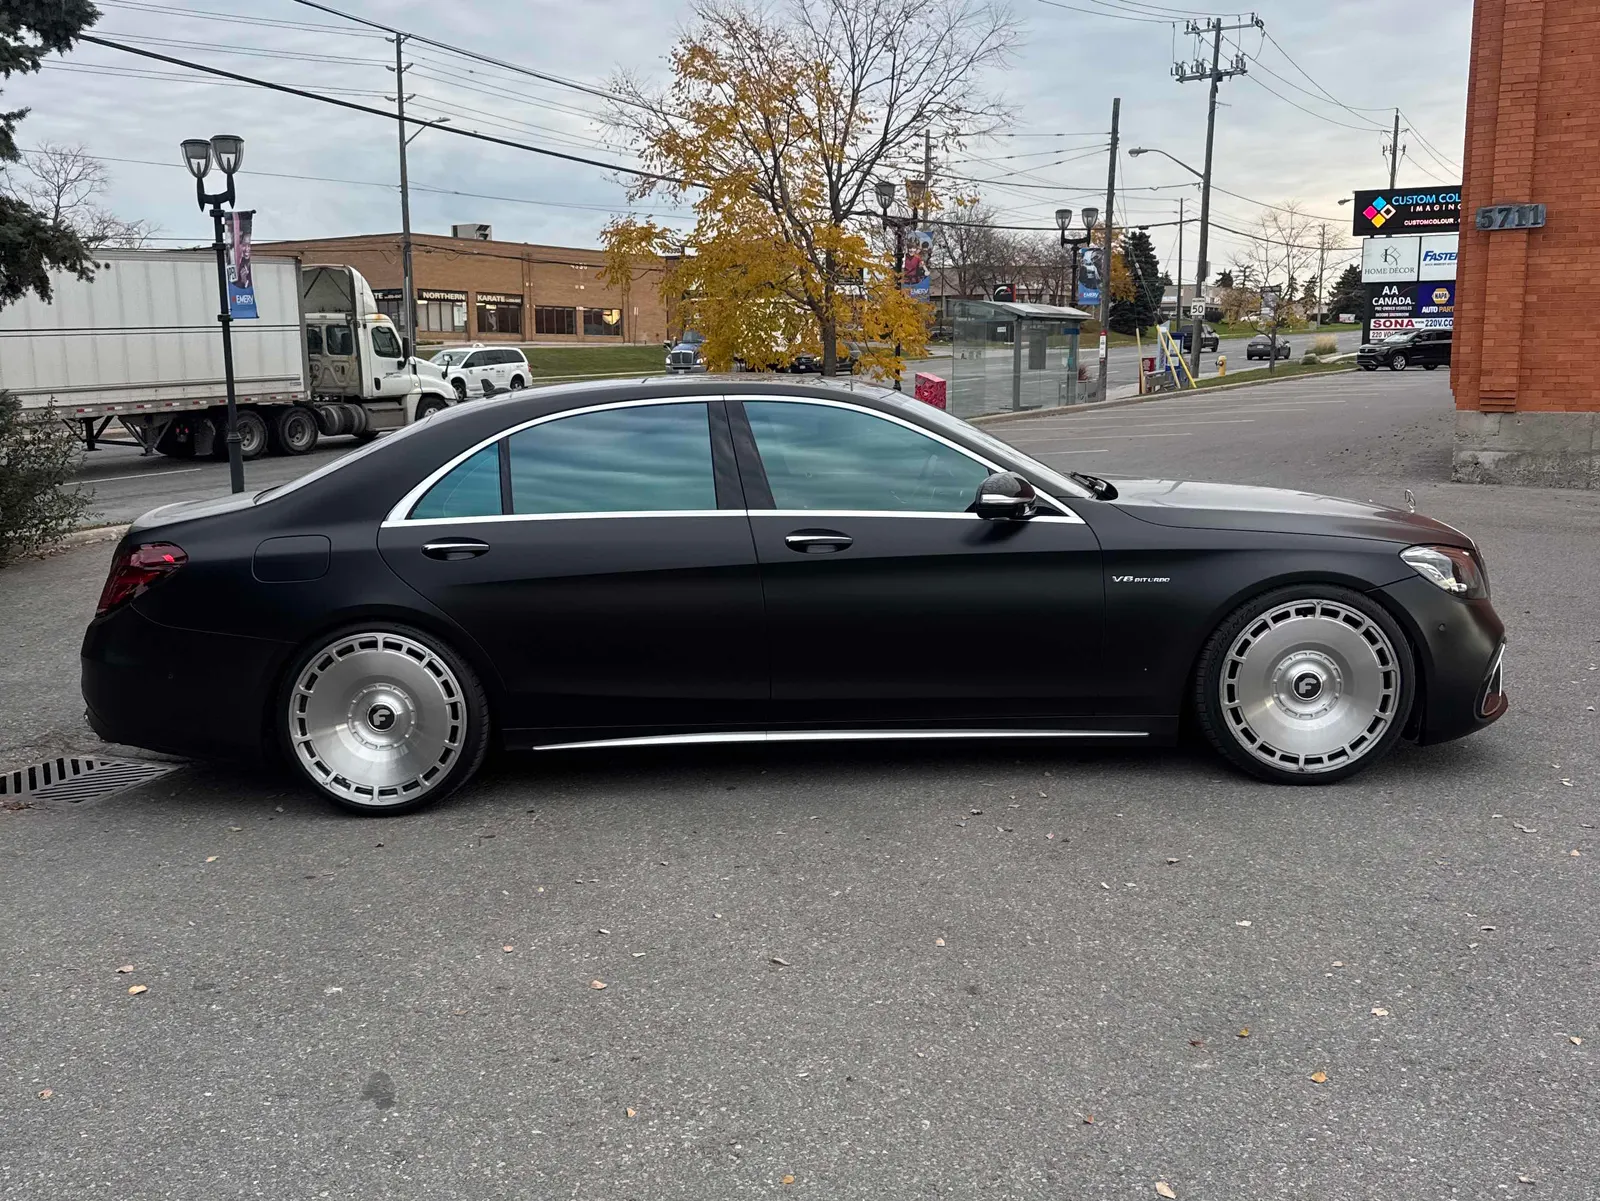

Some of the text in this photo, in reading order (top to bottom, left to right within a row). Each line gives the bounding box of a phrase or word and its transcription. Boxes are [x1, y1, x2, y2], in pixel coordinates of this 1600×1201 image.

[1391, 193, 1461, 205] CUSTOM COL
[1480, 205, 1541, 229] 5711
[1382, 285, 1399, 295] AA
[423, 291, 466, 300] NORTHERN
[477, 294, 505, 302] KARATE
[1372, 296, 1412, 305] CANADA
[1192, 305, 1204, 314] 50
[1372, 319, 1415, 328] SONA
[1112, 575, 1134, 583] V8
[1299, 677, 1317, 693] F
[373, 709, 391, 726] F
